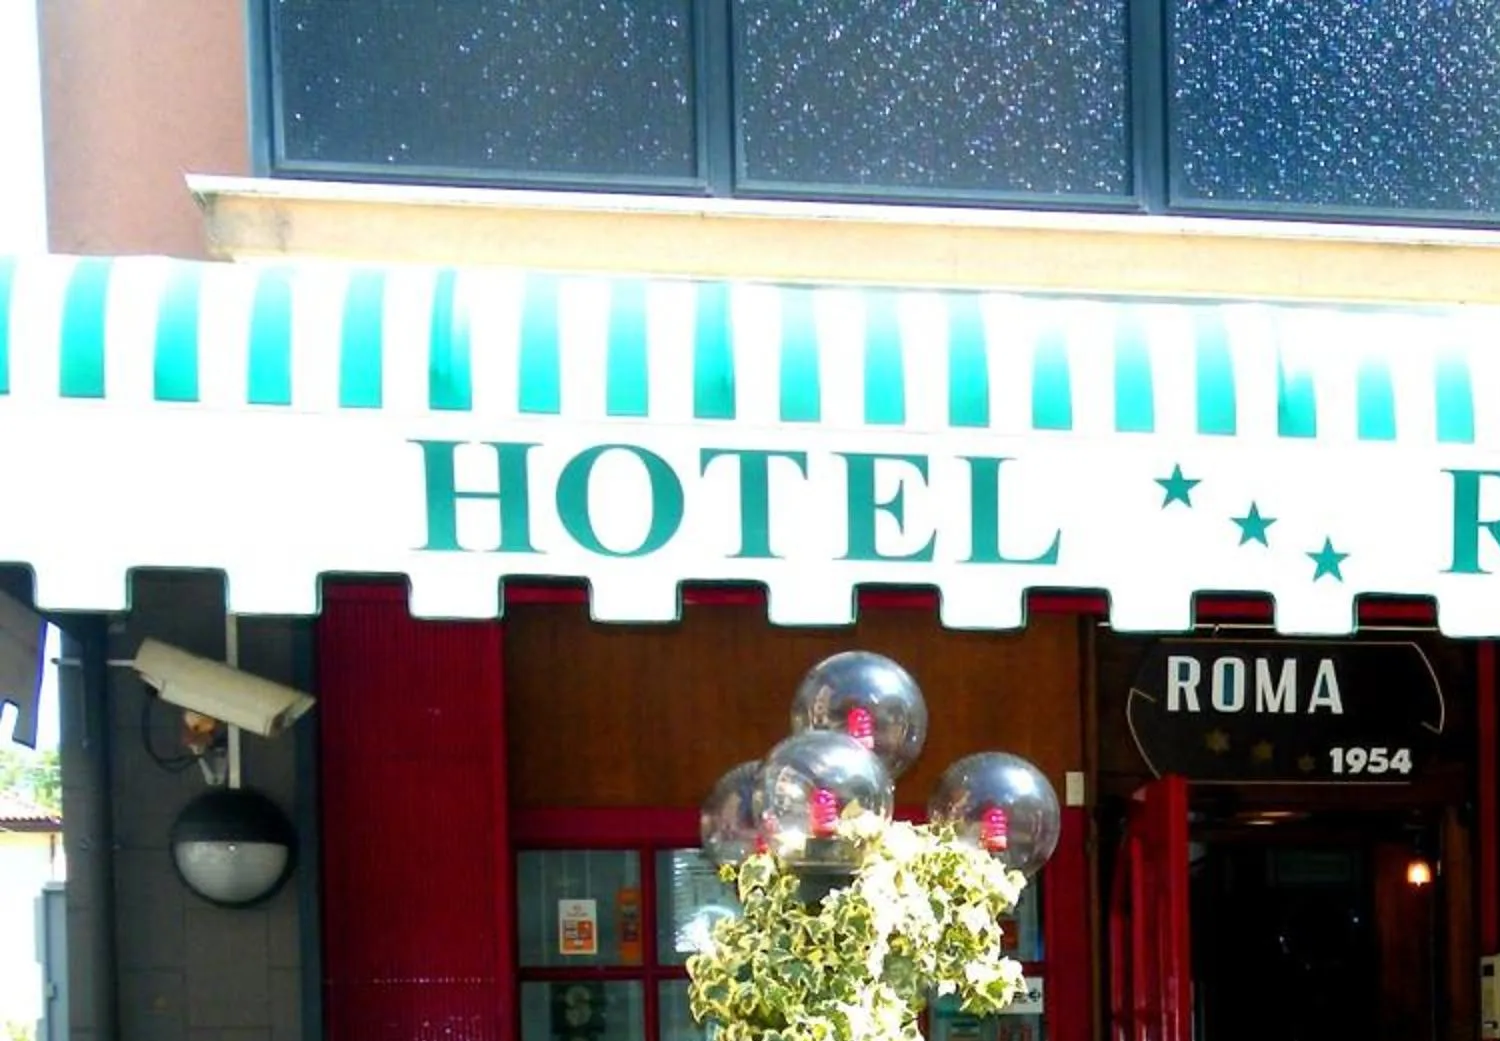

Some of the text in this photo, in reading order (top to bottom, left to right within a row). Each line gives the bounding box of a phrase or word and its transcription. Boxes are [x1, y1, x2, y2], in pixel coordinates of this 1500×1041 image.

[406, 439, 1062, 566] HOTEL
[1167, 655, 1344, 714] ROMA
[1329, 747, 1413, 774] 1954
